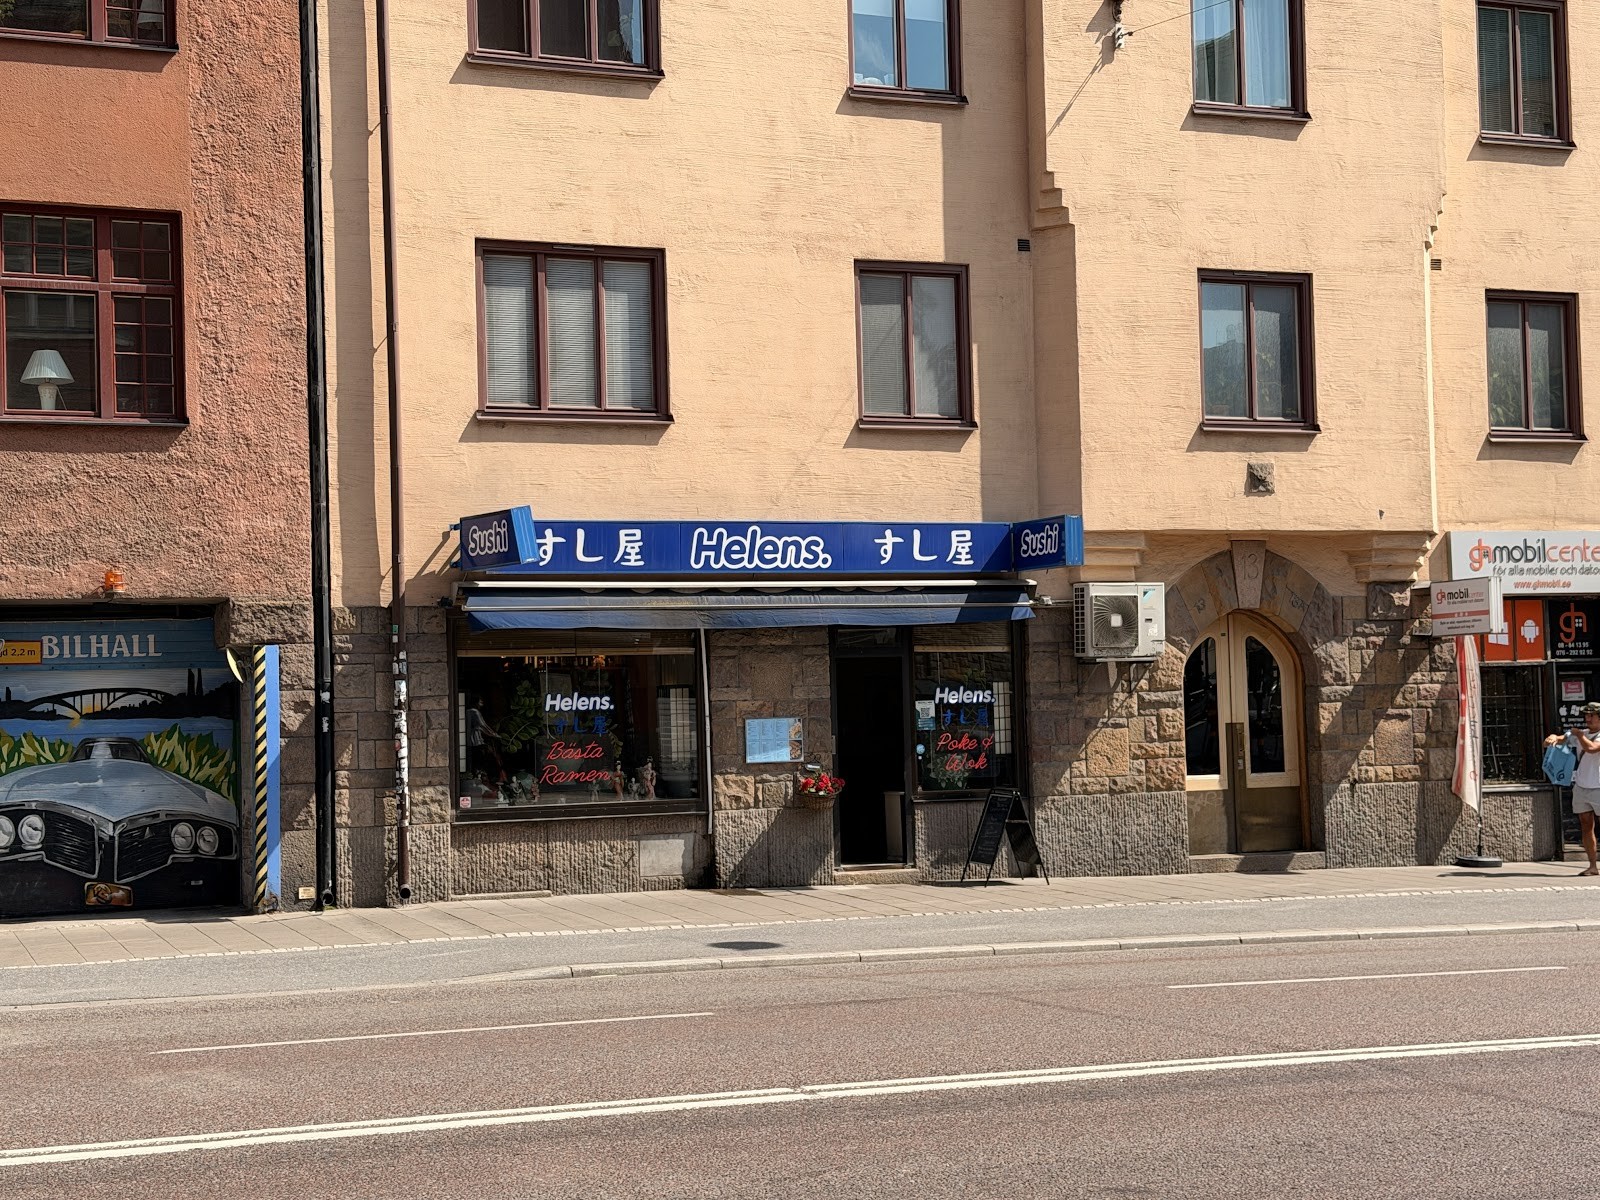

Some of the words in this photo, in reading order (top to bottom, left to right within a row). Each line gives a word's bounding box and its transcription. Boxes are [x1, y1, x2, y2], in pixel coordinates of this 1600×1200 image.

[468, 519, 509, 557] Sushi
[536, 528, 646, 567] すし屋
[690, 525, 832, 569] Helens.
[873, 528, 976, 566] すし屋
[1020, 523, 1059, 557] Sushi
[1241, 553, 1259, 580] 13
[1508, 564, 1525, 576] alla
[1526, 564, 1559, 576] mobiler
[1560, 564, 1578, 576] och
[11, 648, 26, 656] 2,2
[41, 634, 163, 659] BILHALL
[545, 692, 615, 711] Helens.
[935, 685, 997, 704] Helens.
[546, 741, 604, 760] Bästa
[936, 732, 978, 751] Poke
[945, 752, 988, 771] Wok
[540, 764, 611, 786] Ramen
